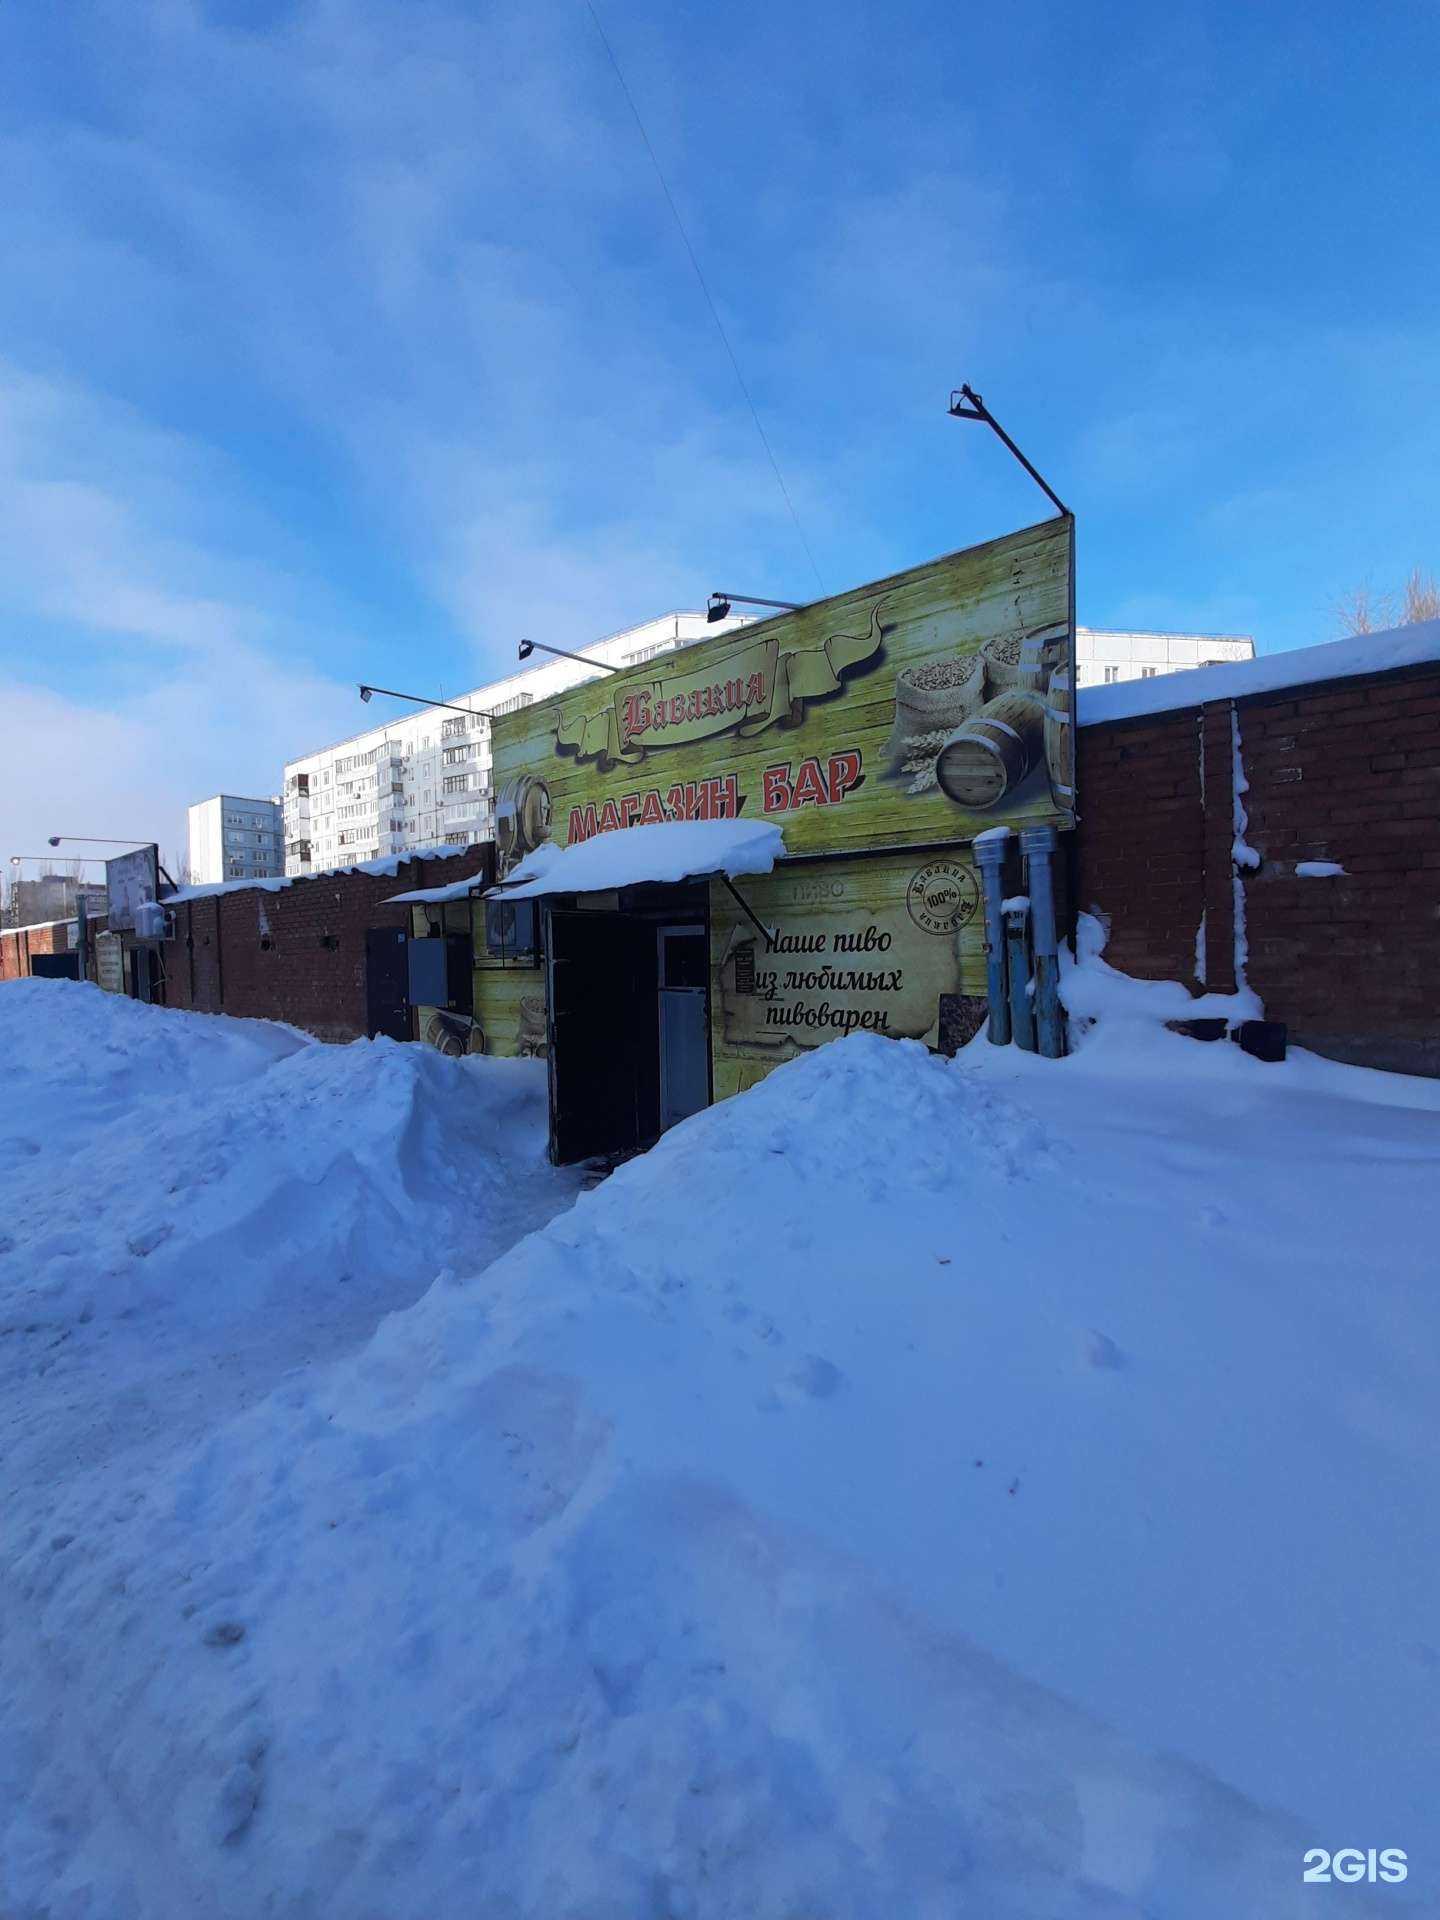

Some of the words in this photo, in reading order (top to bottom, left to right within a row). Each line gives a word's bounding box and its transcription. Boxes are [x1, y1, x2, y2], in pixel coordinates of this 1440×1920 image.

[567, 773, 739, 844] МАГАЗИН
[762, 750, 863, 815] БАР
[927, 888, 957, 909] 100%
[765, 929, 826, 953] Наше
[833, 926, 892, 953] пиво
[755, 970, 778, 1000] из
[783, 966, 903, 991] любимых
[766, 1002, 890, 1035] пивоварен
